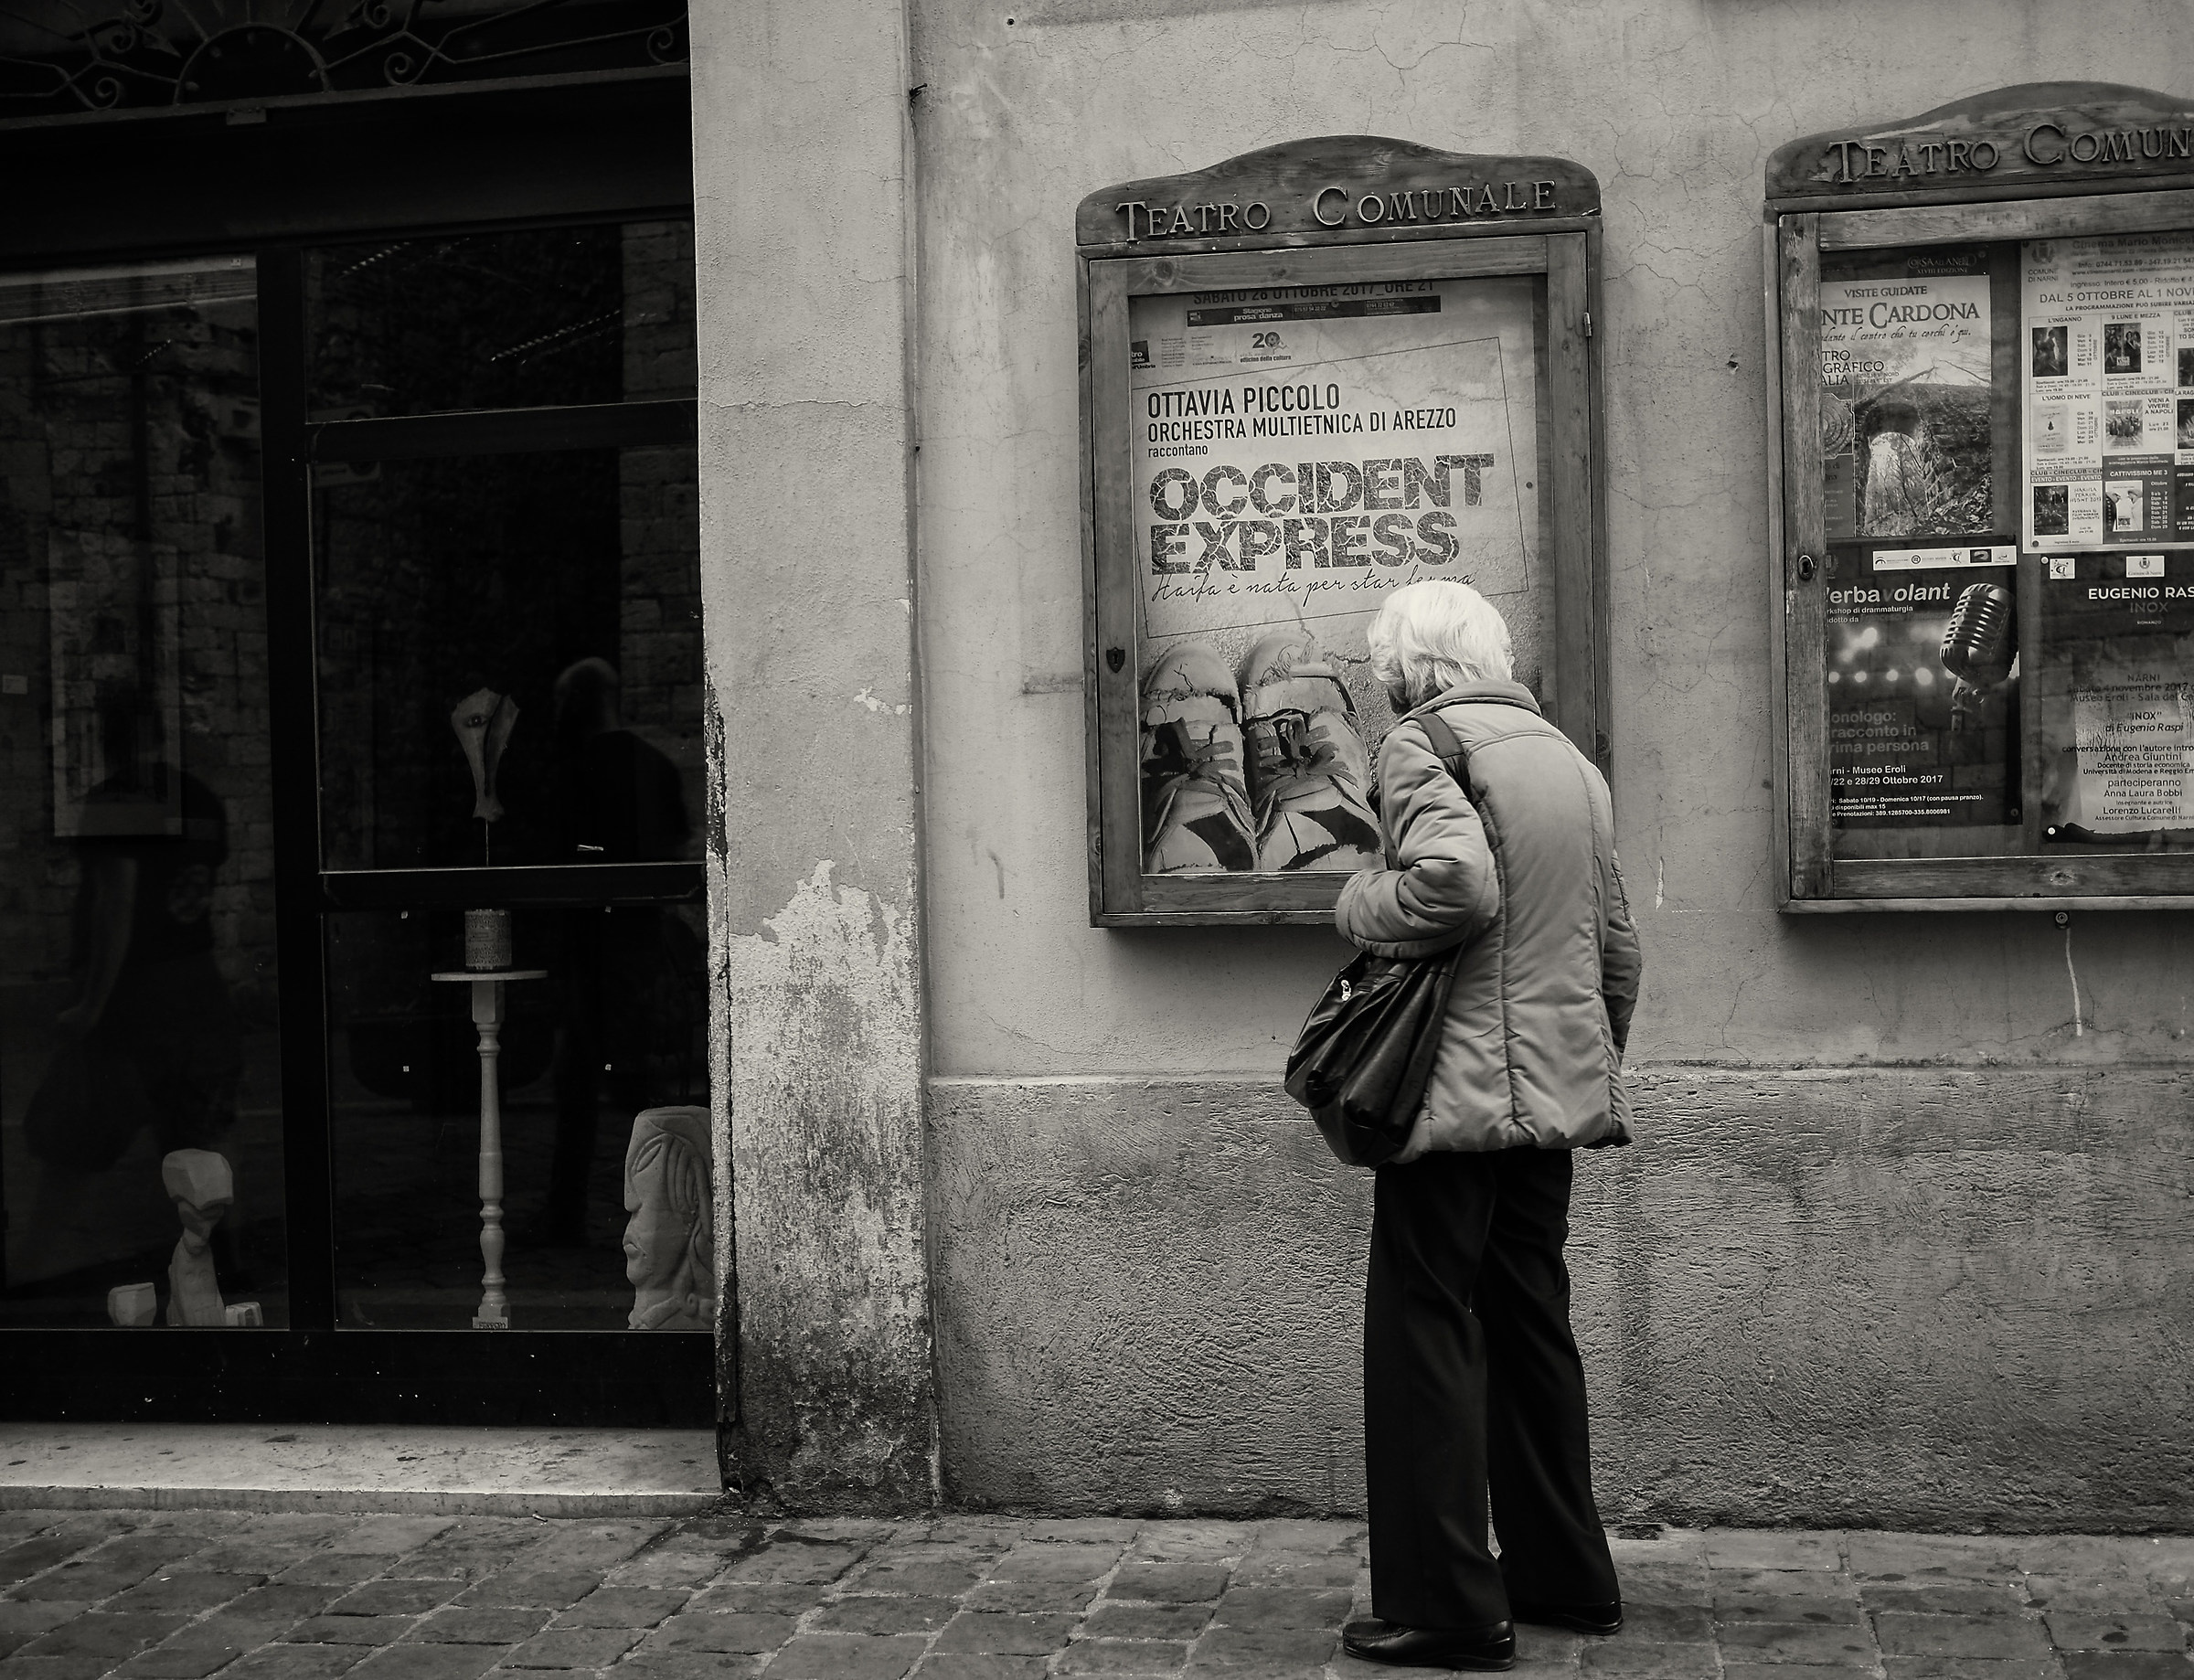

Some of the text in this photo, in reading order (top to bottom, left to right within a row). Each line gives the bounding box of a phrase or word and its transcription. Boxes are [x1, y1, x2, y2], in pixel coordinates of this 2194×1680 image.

[1829, 137, 2000, 183] TEATRO
[1115, 180, 1556, 242] TEATRO COMUNALE
[1844, 285, 1928, 298] VISITE GUIDATE
[2040, 292, 2064, 303] DAL
[2067, 292, 2073, 302] 5
[2077, 290, 2134, 301] OTTOBRE
[2137, 289, 2153, 298] AL
[2074, 303, 2134, 311] PROGRAMMAZIONE
[1869, 302, 1981, 329] CARDONA
[1823, 360, 1885, 373] GRAFICO
[1147, 383, 1340, 420] OTTAVIA PICCOLO
[1147, 407, 1457, 442] ORCHESTRA MULTIETNICA DI AREZZO
[1147, 444, 1209, 458] raccontano
[1149, 452, 1496, 521] OCCIDENT
[1149, 510, 1461, 576] EXPRESS
[1245, 571, 1302, 593] nata
[1305, 578, 1347, 608] per
[1350, 569, 1400, 592] star
[2088, 587, 2160, 600] EUGENIO
[1861, 605, 1913, 613] drammaturgia
[2130, 601, 2168, 613] INOX
[2127, 674, 2161, 683] NARNI
[2111, 683, 2162, 692] novembre
[2164, 682, 2189, 692] 2017
[1902, 724, 1917, 737] in
[2116, 723, 2156, 734] Eugenio
[2157, 722, 2184, 733] Raspi
[1867, 740, 1930, 756] persona
[2139, 743, 2172, 752] l'autore
[2104, 751, 2182, 761] Andrea Giuntini
[1852, 766, 1883, 775] Museo
[1884, 764, 1907, 774] Eroli
[1855, 776, 1880, 785] 28/29
[1882, 775, 1919, 785] Ottobre
[1920, 774, 1944, 784] 2017
[2107, 778, 2181, 789] parteciperanno
[2103, 788, 2183, 797] Anna Laura Bobbi
[2103, 805, 2181, 814] Lorenzo Lucarelli
